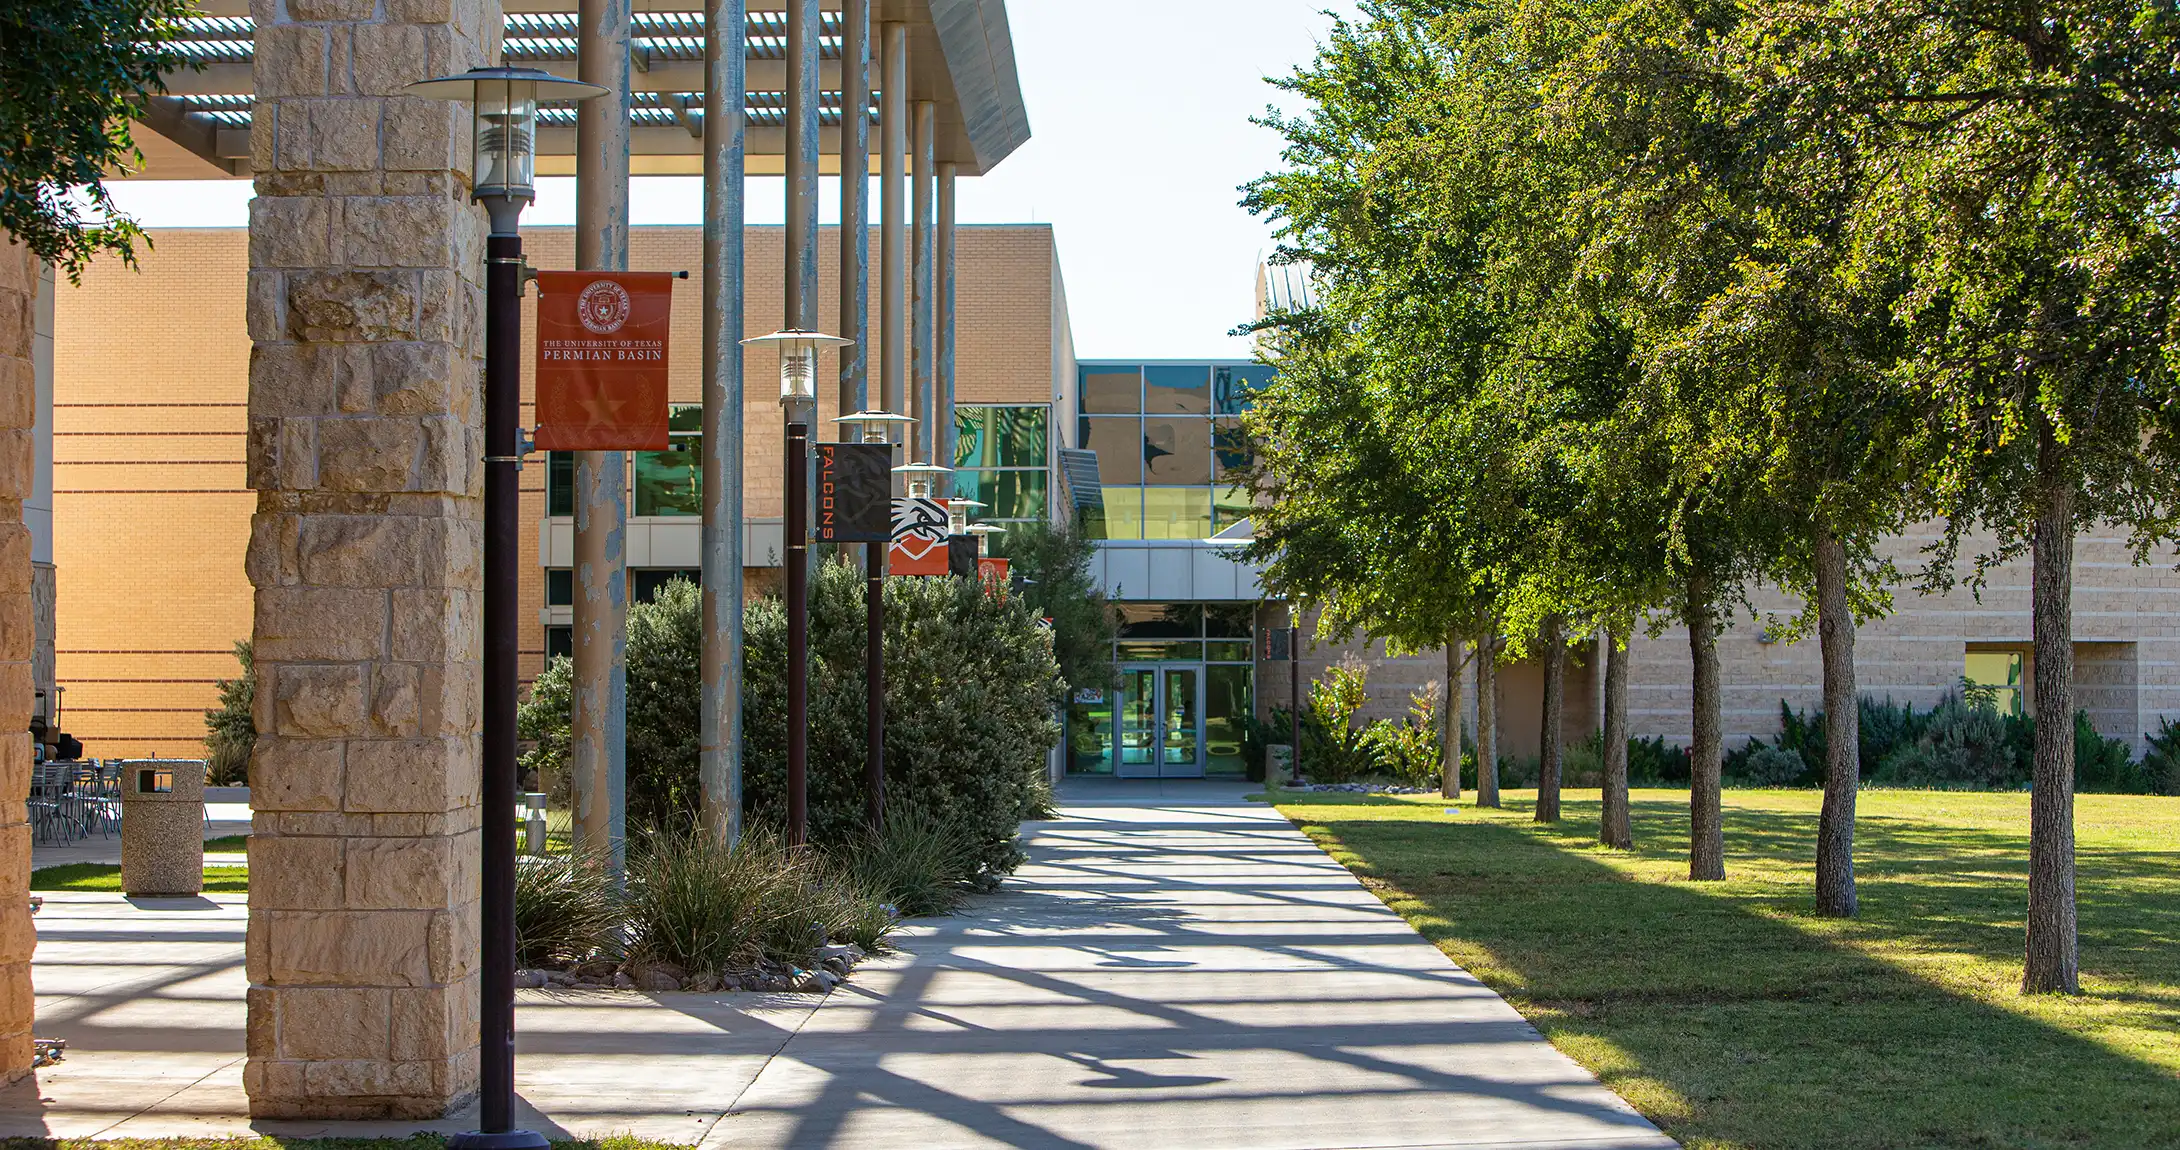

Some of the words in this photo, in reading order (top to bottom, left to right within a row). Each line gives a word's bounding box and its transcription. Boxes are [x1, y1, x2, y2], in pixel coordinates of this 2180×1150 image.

[544, 350, 611, 360] PERMIAN
[618, 350, 662, 360] BASIN
[823, 446, 834, 539] FALCONS
